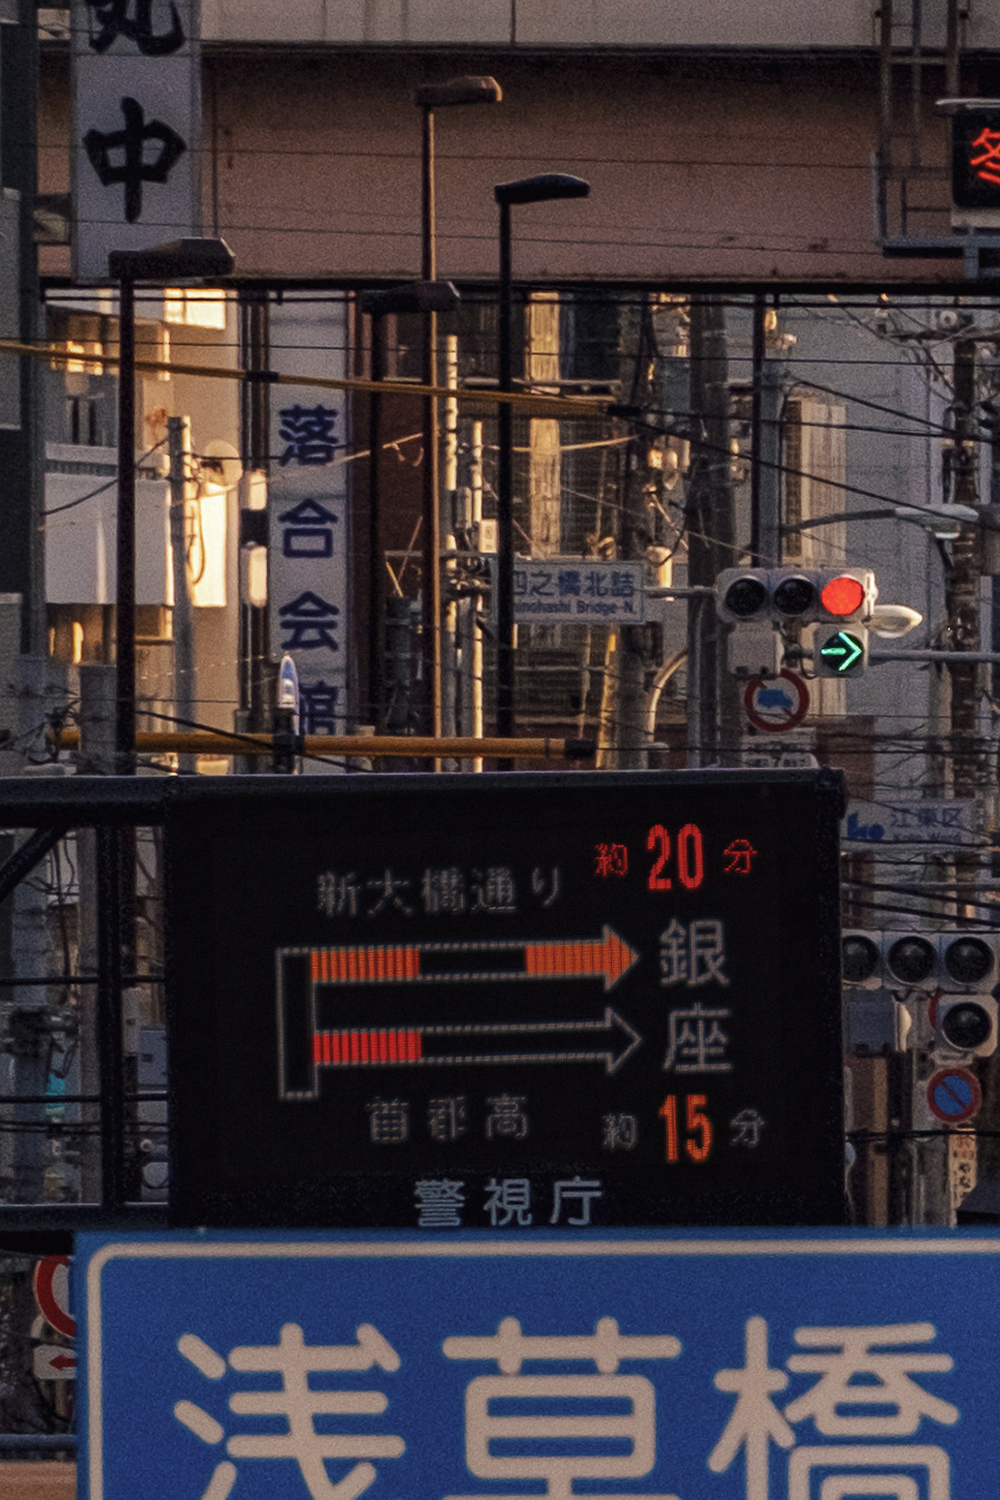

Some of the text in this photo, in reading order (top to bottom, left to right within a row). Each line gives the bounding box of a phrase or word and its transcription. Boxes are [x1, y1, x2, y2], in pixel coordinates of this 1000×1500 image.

[316, 866, 562, 917] 新大橋通り
[659, 918, 733, 1074] 銀座
[413, 1177, 604, 1227] 警視庁
[173, 1315, 962, 1500] 浅草橋
